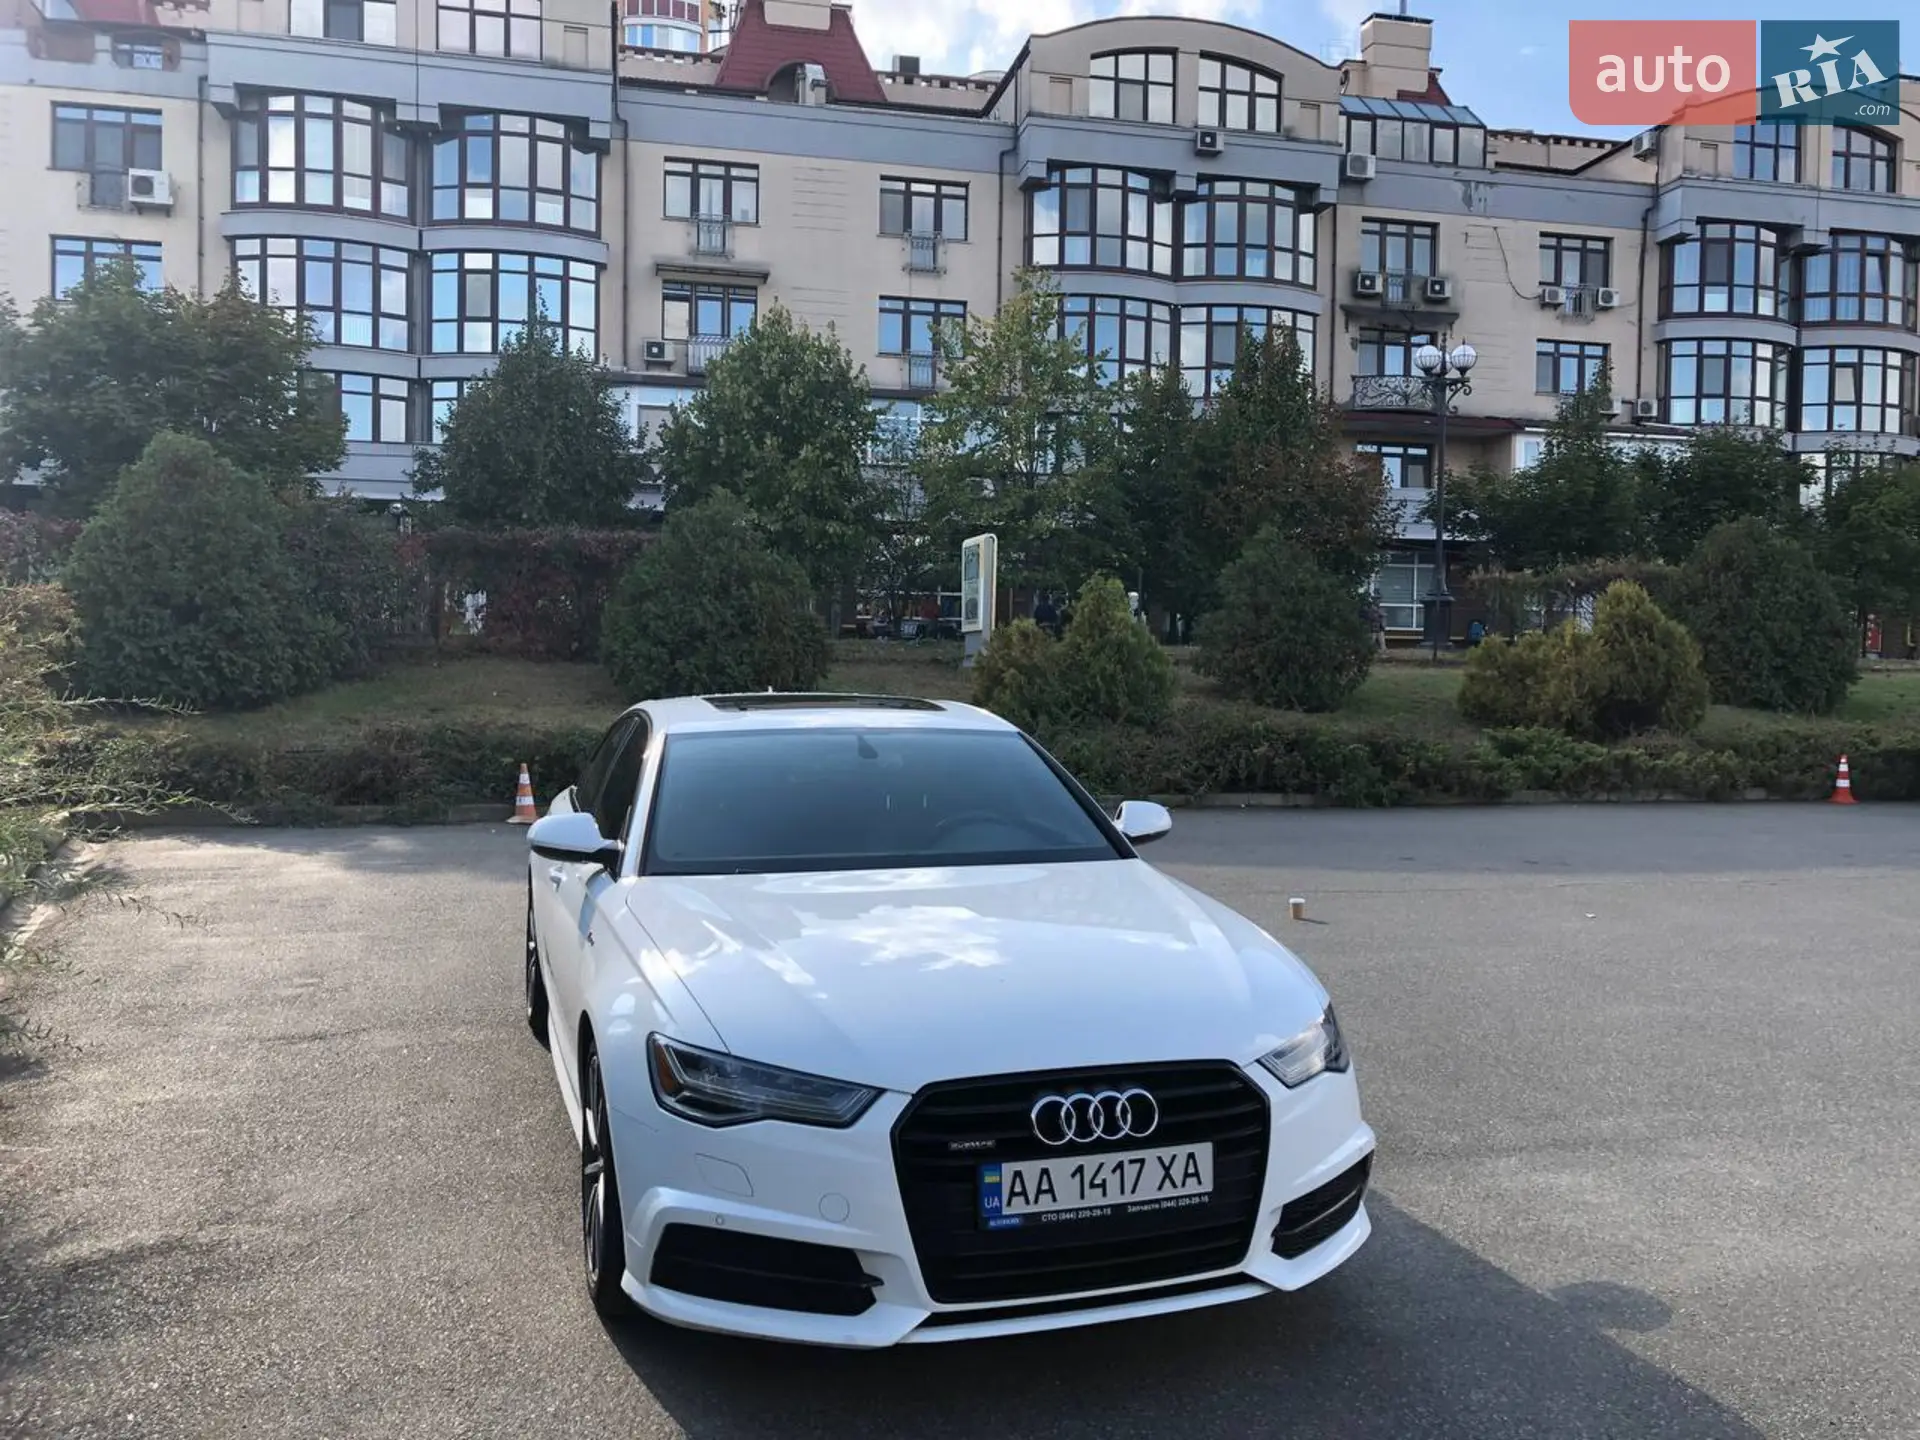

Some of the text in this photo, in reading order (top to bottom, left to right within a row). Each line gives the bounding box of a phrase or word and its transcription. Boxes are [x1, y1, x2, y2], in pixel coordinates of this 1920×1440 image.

[1006, 1151, 1203, 1207] AA 1417 XA
[984, 1197, 1001, 1209] UA
